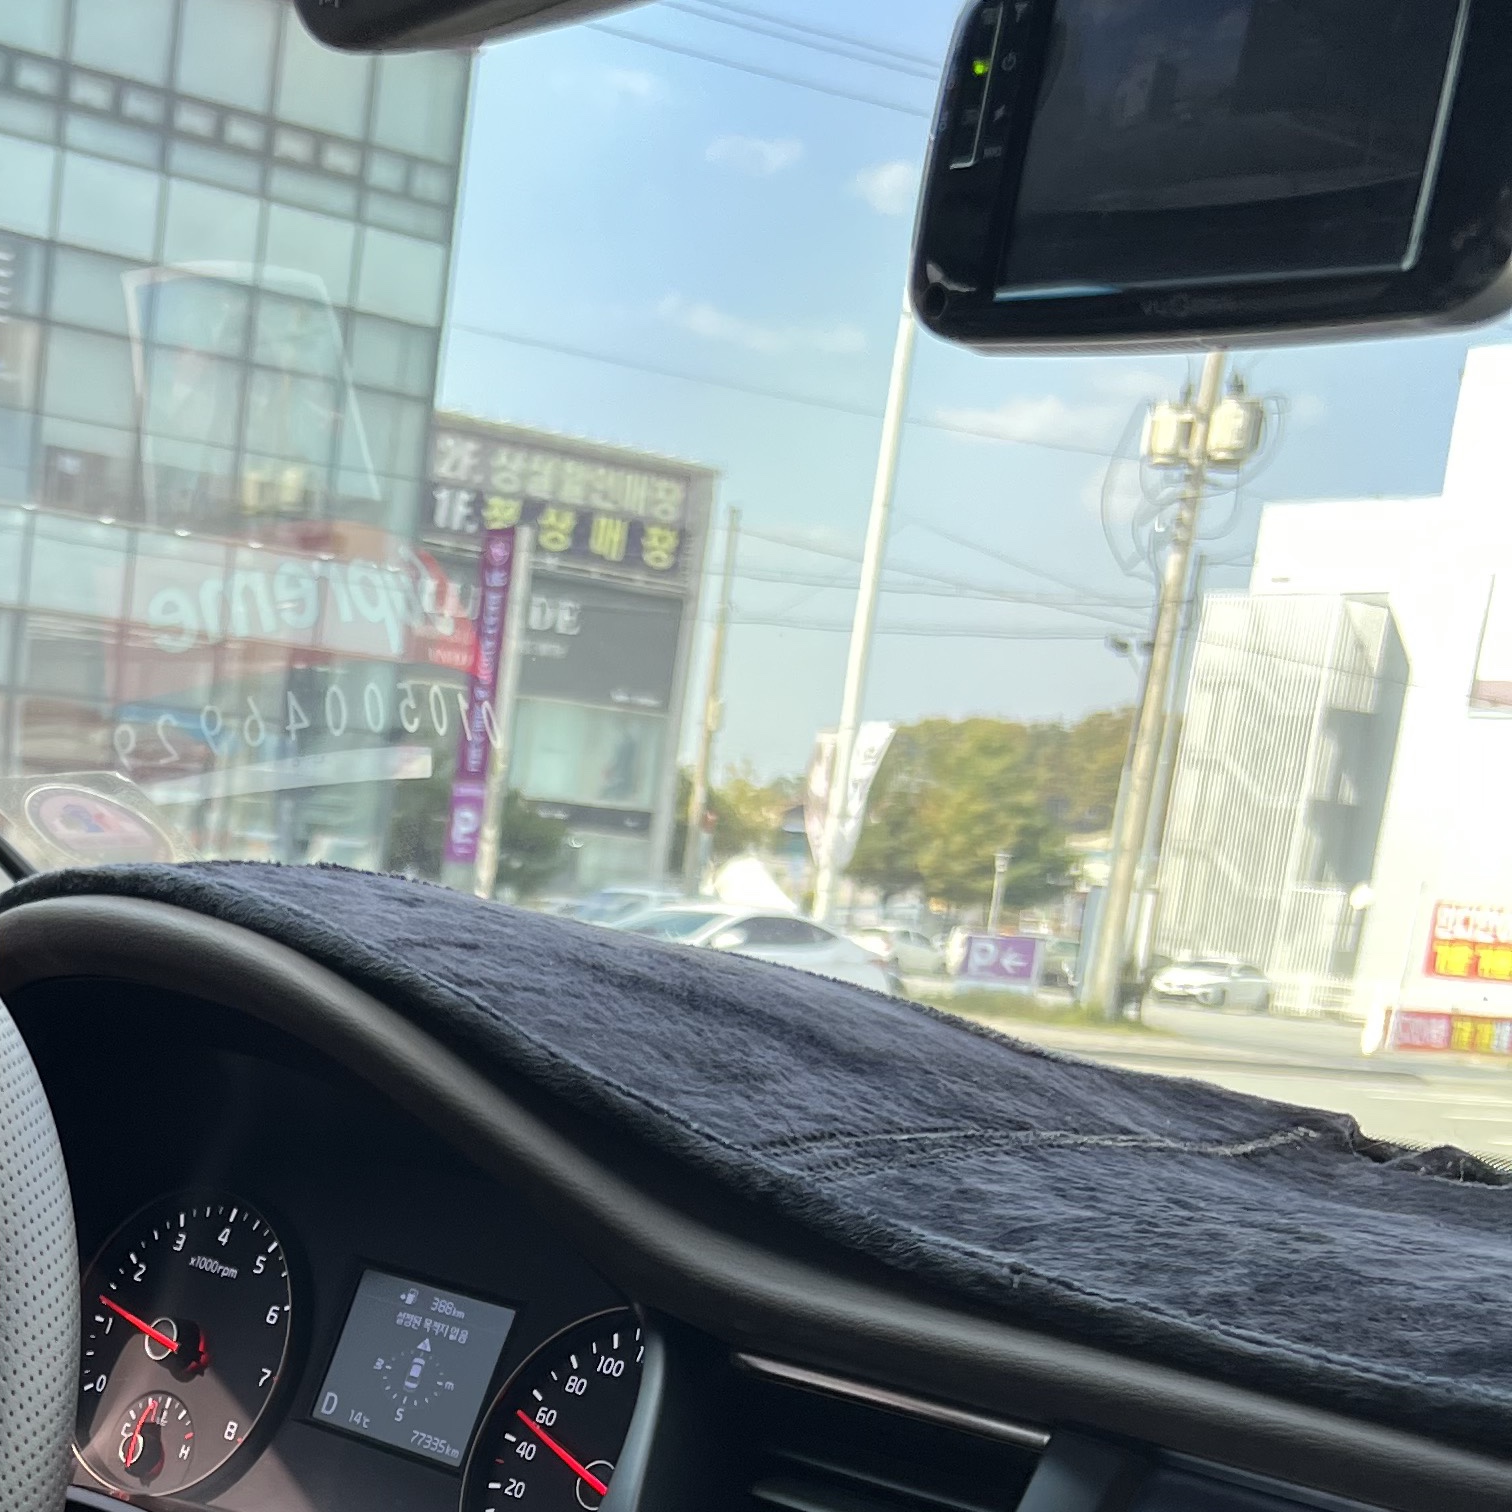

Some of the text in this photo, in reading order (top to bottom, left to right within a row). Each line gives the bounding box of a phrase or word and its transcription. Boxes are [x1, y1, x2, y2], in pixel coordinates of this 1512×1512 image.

[173, 1233, 186, 1252] 3
[217, 1227, 231, 1246] 4
[133, 1264, 147, 1282] 2
[188, 1255, 238, 1280] x1000rpm
[252, 1256, 267, 1274] 5
[104, 1316, 114, 1334] 1
[265, 1306, 280, 1325] 6
[596, 1355, 625, 1378] 100
[94, 1374, 107, 1392] 0
[258, 1368, 272, 1387] 7
[565, 1375, 587, 1396] 80
[321, 1391, 338, 1415] D
[394, 1408, 404, 1422] S
[535, 1406, 557, 1427] 60
[223, 1421, 238, 1441] 8
[178, 1444, 191, 1460] H
[515, 1441, 536, 1461] 40
[504, 1478, 526, 1498] 20
